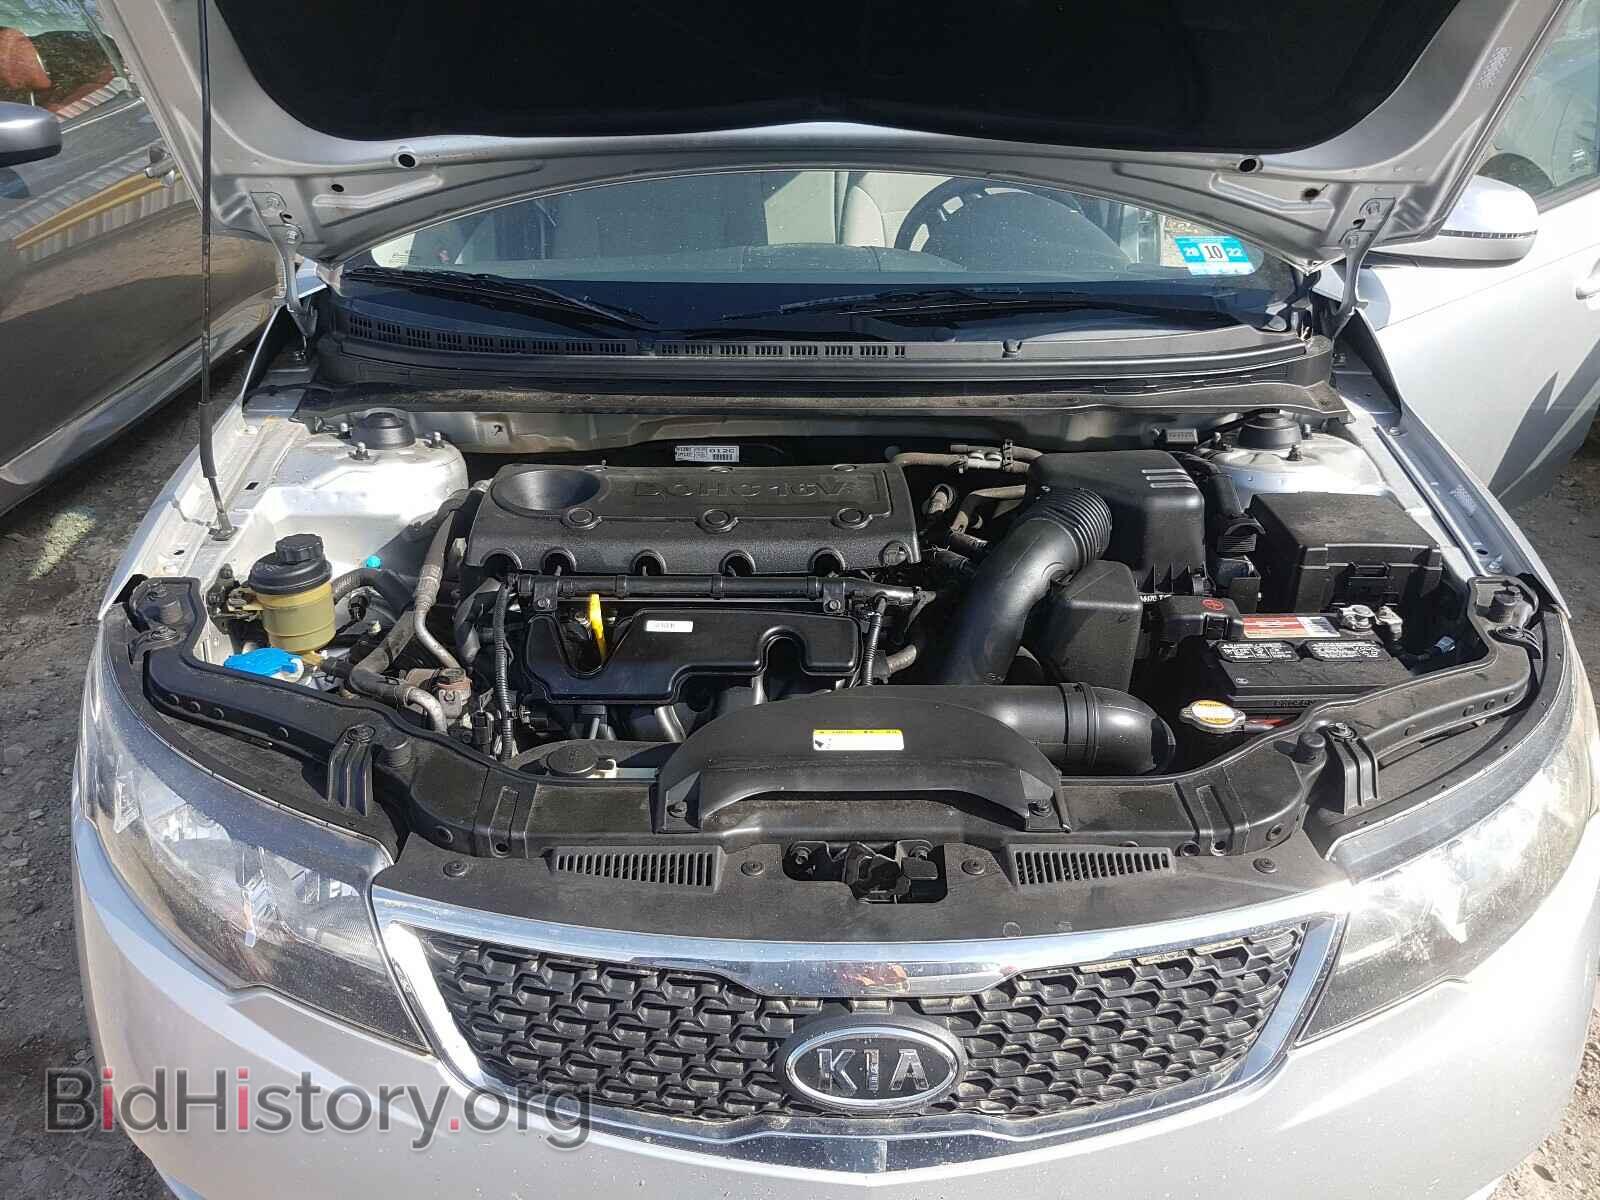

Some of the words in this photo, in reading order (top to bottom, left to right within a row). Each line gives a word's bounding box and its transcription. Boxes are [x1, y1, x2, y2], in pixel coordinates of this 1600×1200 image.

[634, 480, 760, 497] DOHC
[769, 480, 847, 497] 16V
[816, 1048, 930, 1092] KIA
